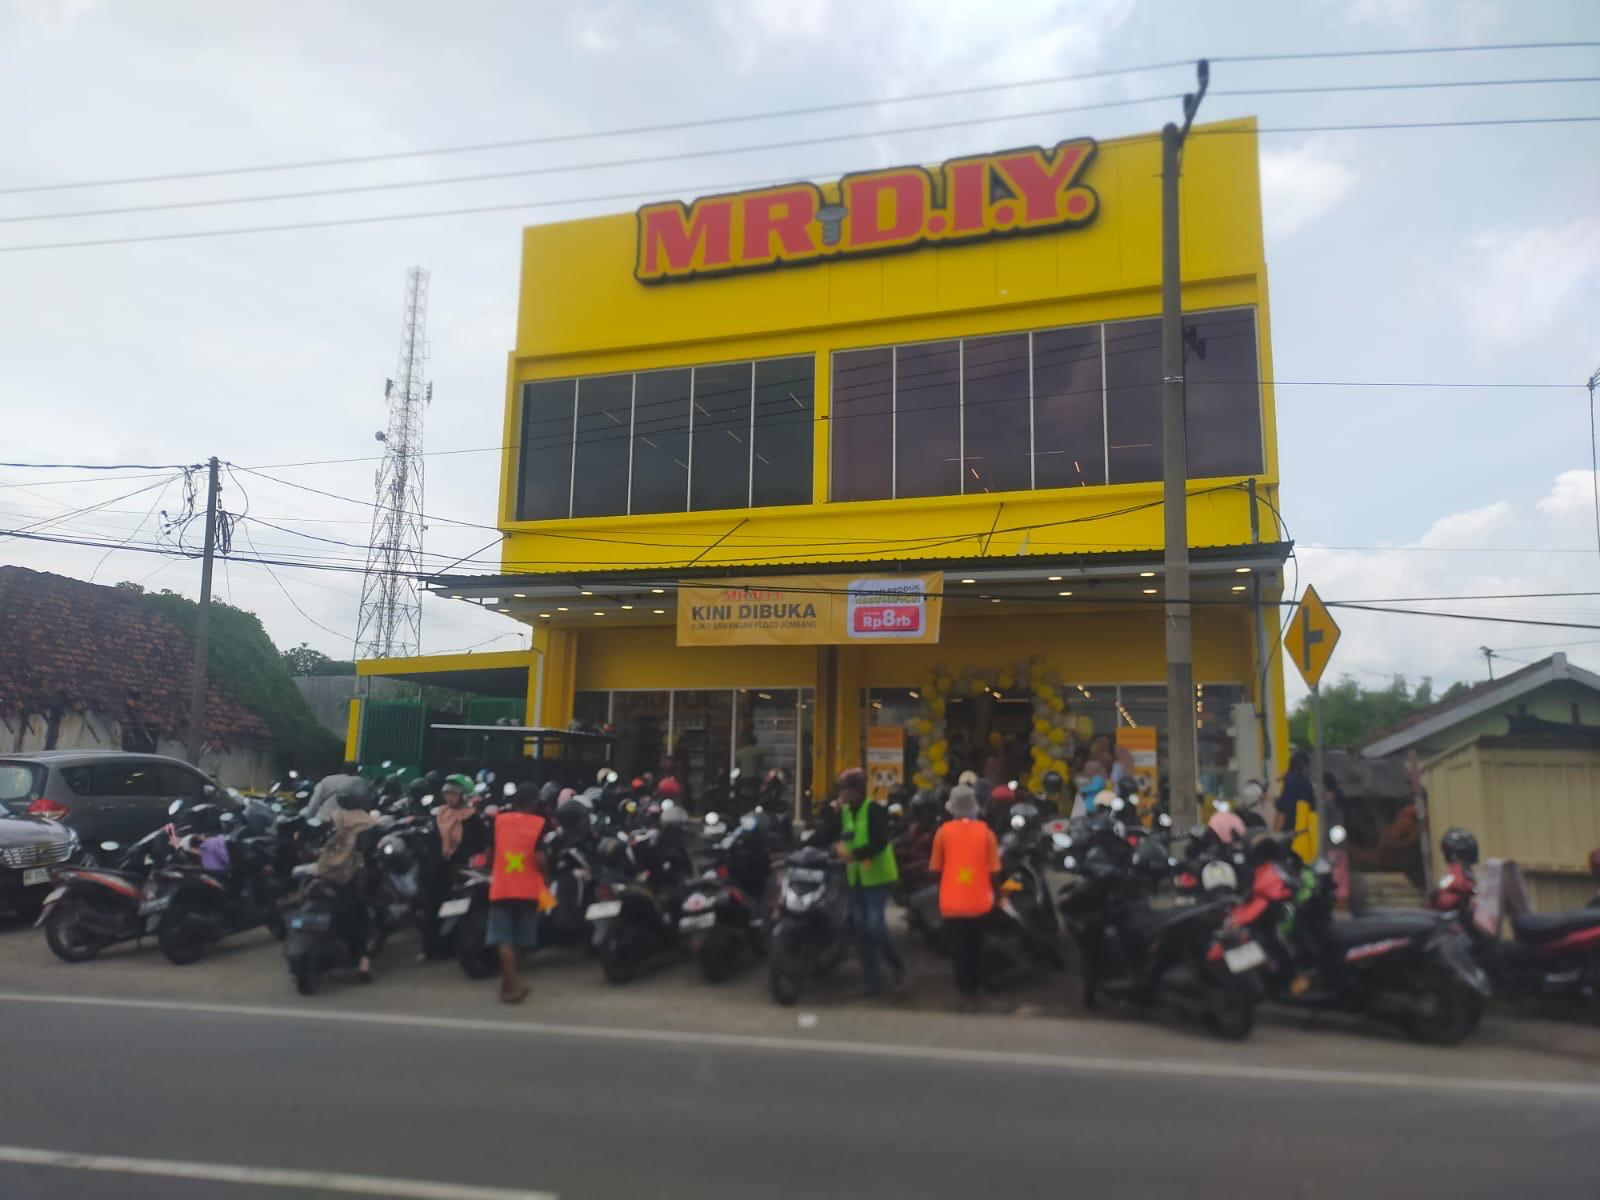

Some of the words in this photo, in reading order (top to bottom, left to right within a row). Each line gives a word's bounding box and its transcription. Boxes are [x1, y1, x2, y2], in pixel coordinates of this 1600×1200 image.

[692, 606, 731, 620] KINI
[739, 604, 817, 619] DIBUKA
[863, 609, 911, 629] Rp8rb
